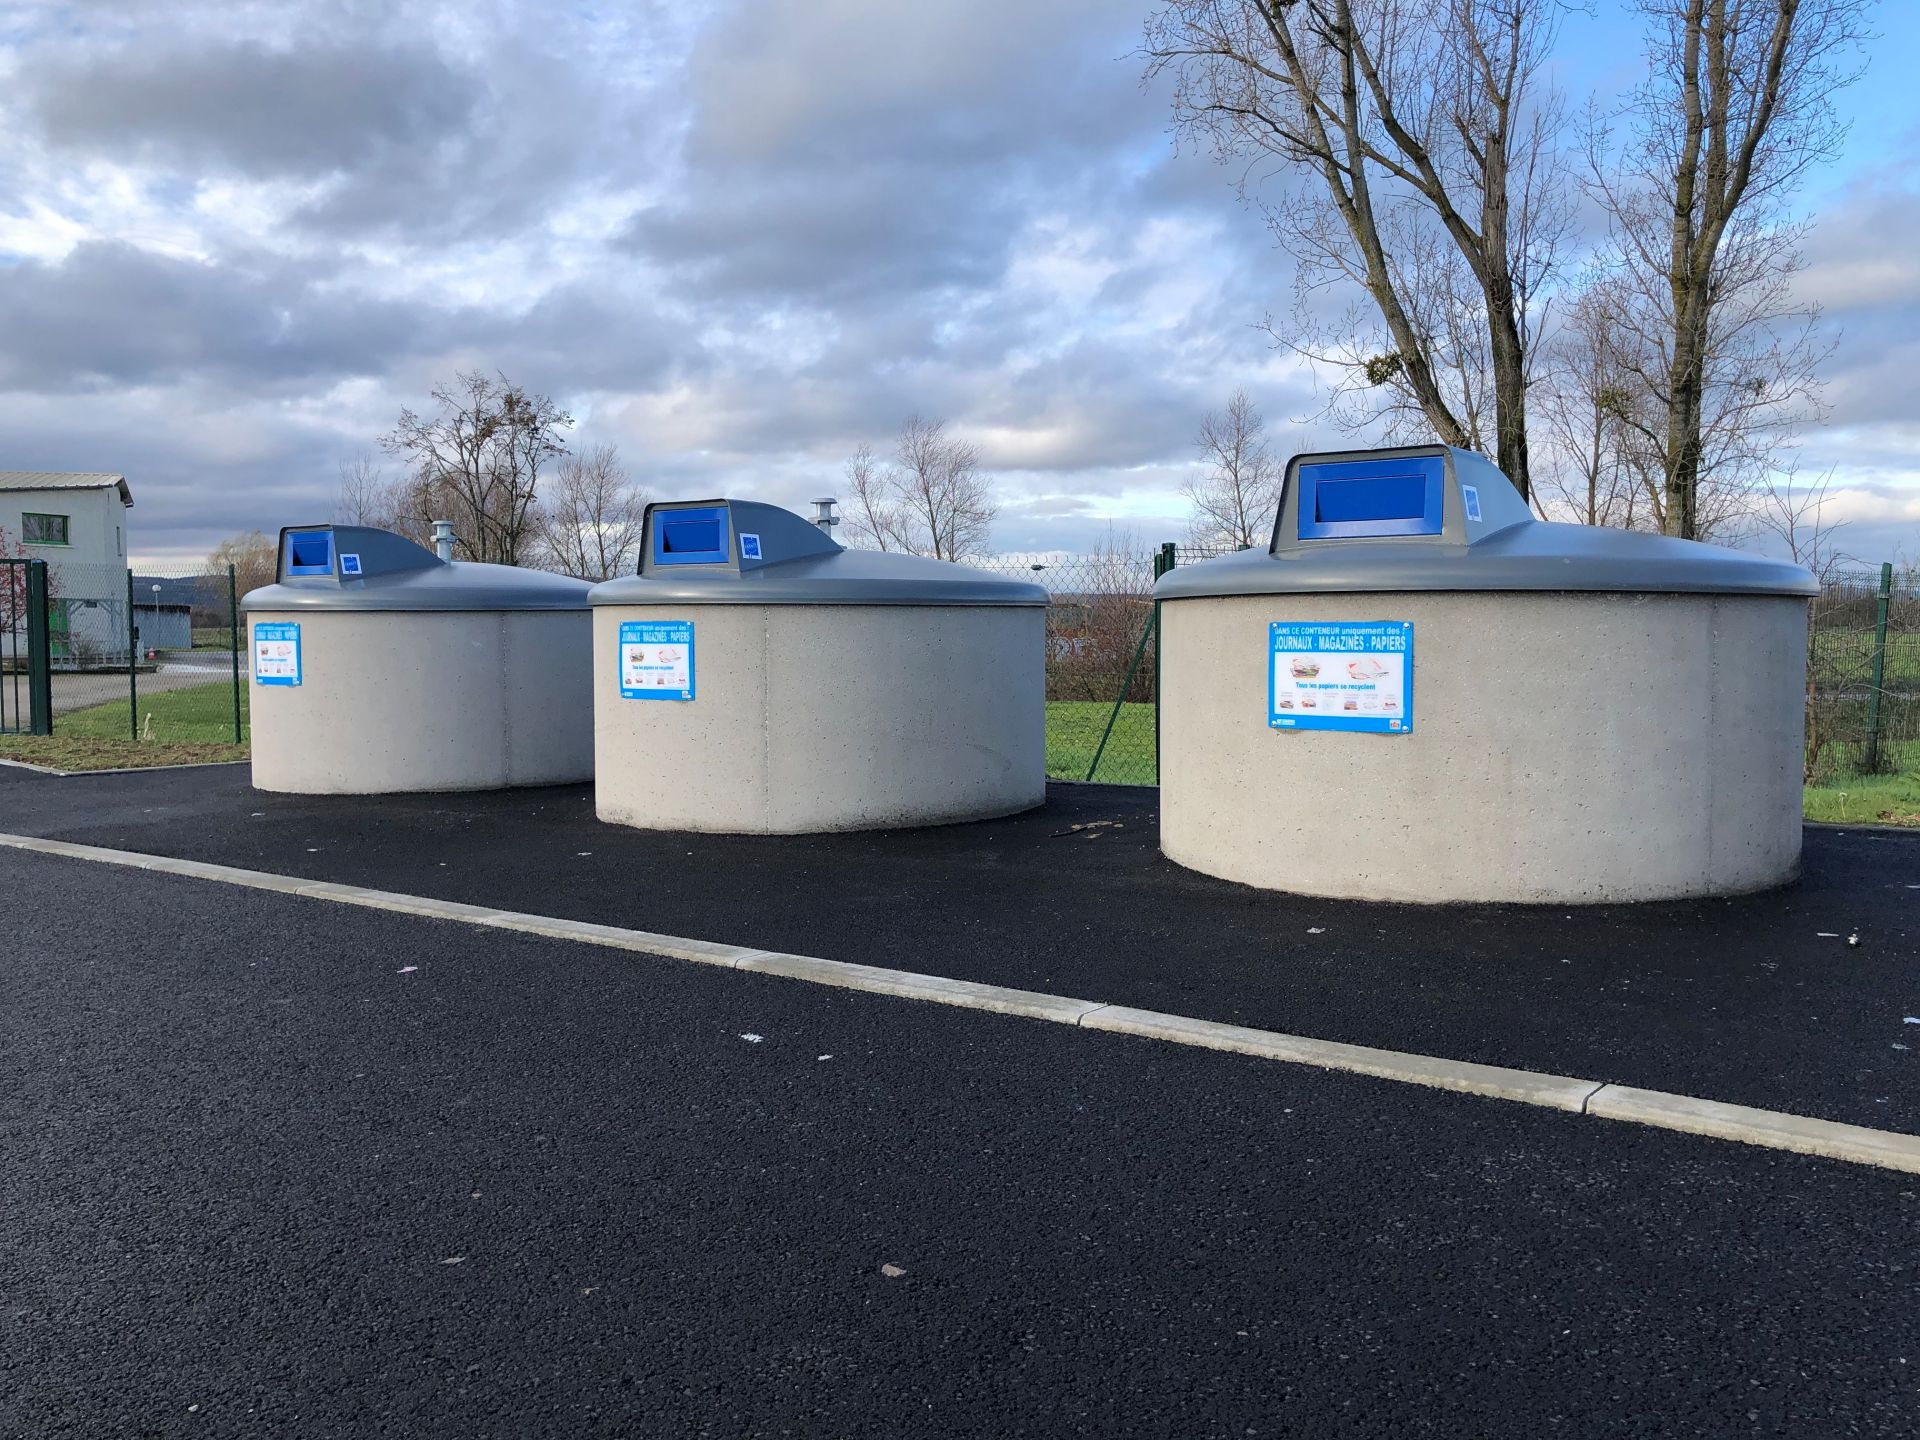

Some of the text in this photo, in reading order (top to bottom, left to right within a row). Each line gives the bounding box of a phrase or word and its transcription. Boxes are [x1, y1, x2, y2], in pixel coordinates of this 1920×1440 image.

[1291, 627, 1300, 635] CE
[1301, 627, 1340, 635] CONTENEUR
[1342, 627, 1384, 636] uniquement
[1386, 626, 1400, 635] des
[1274, 636, 1312, 650] JOURNAUX
[1319, 636, 1364, 650] MAGAZINES
[1371, 636, 1406, 651] PAPIERS
[1348, 683, 1376, 691] recyclent
